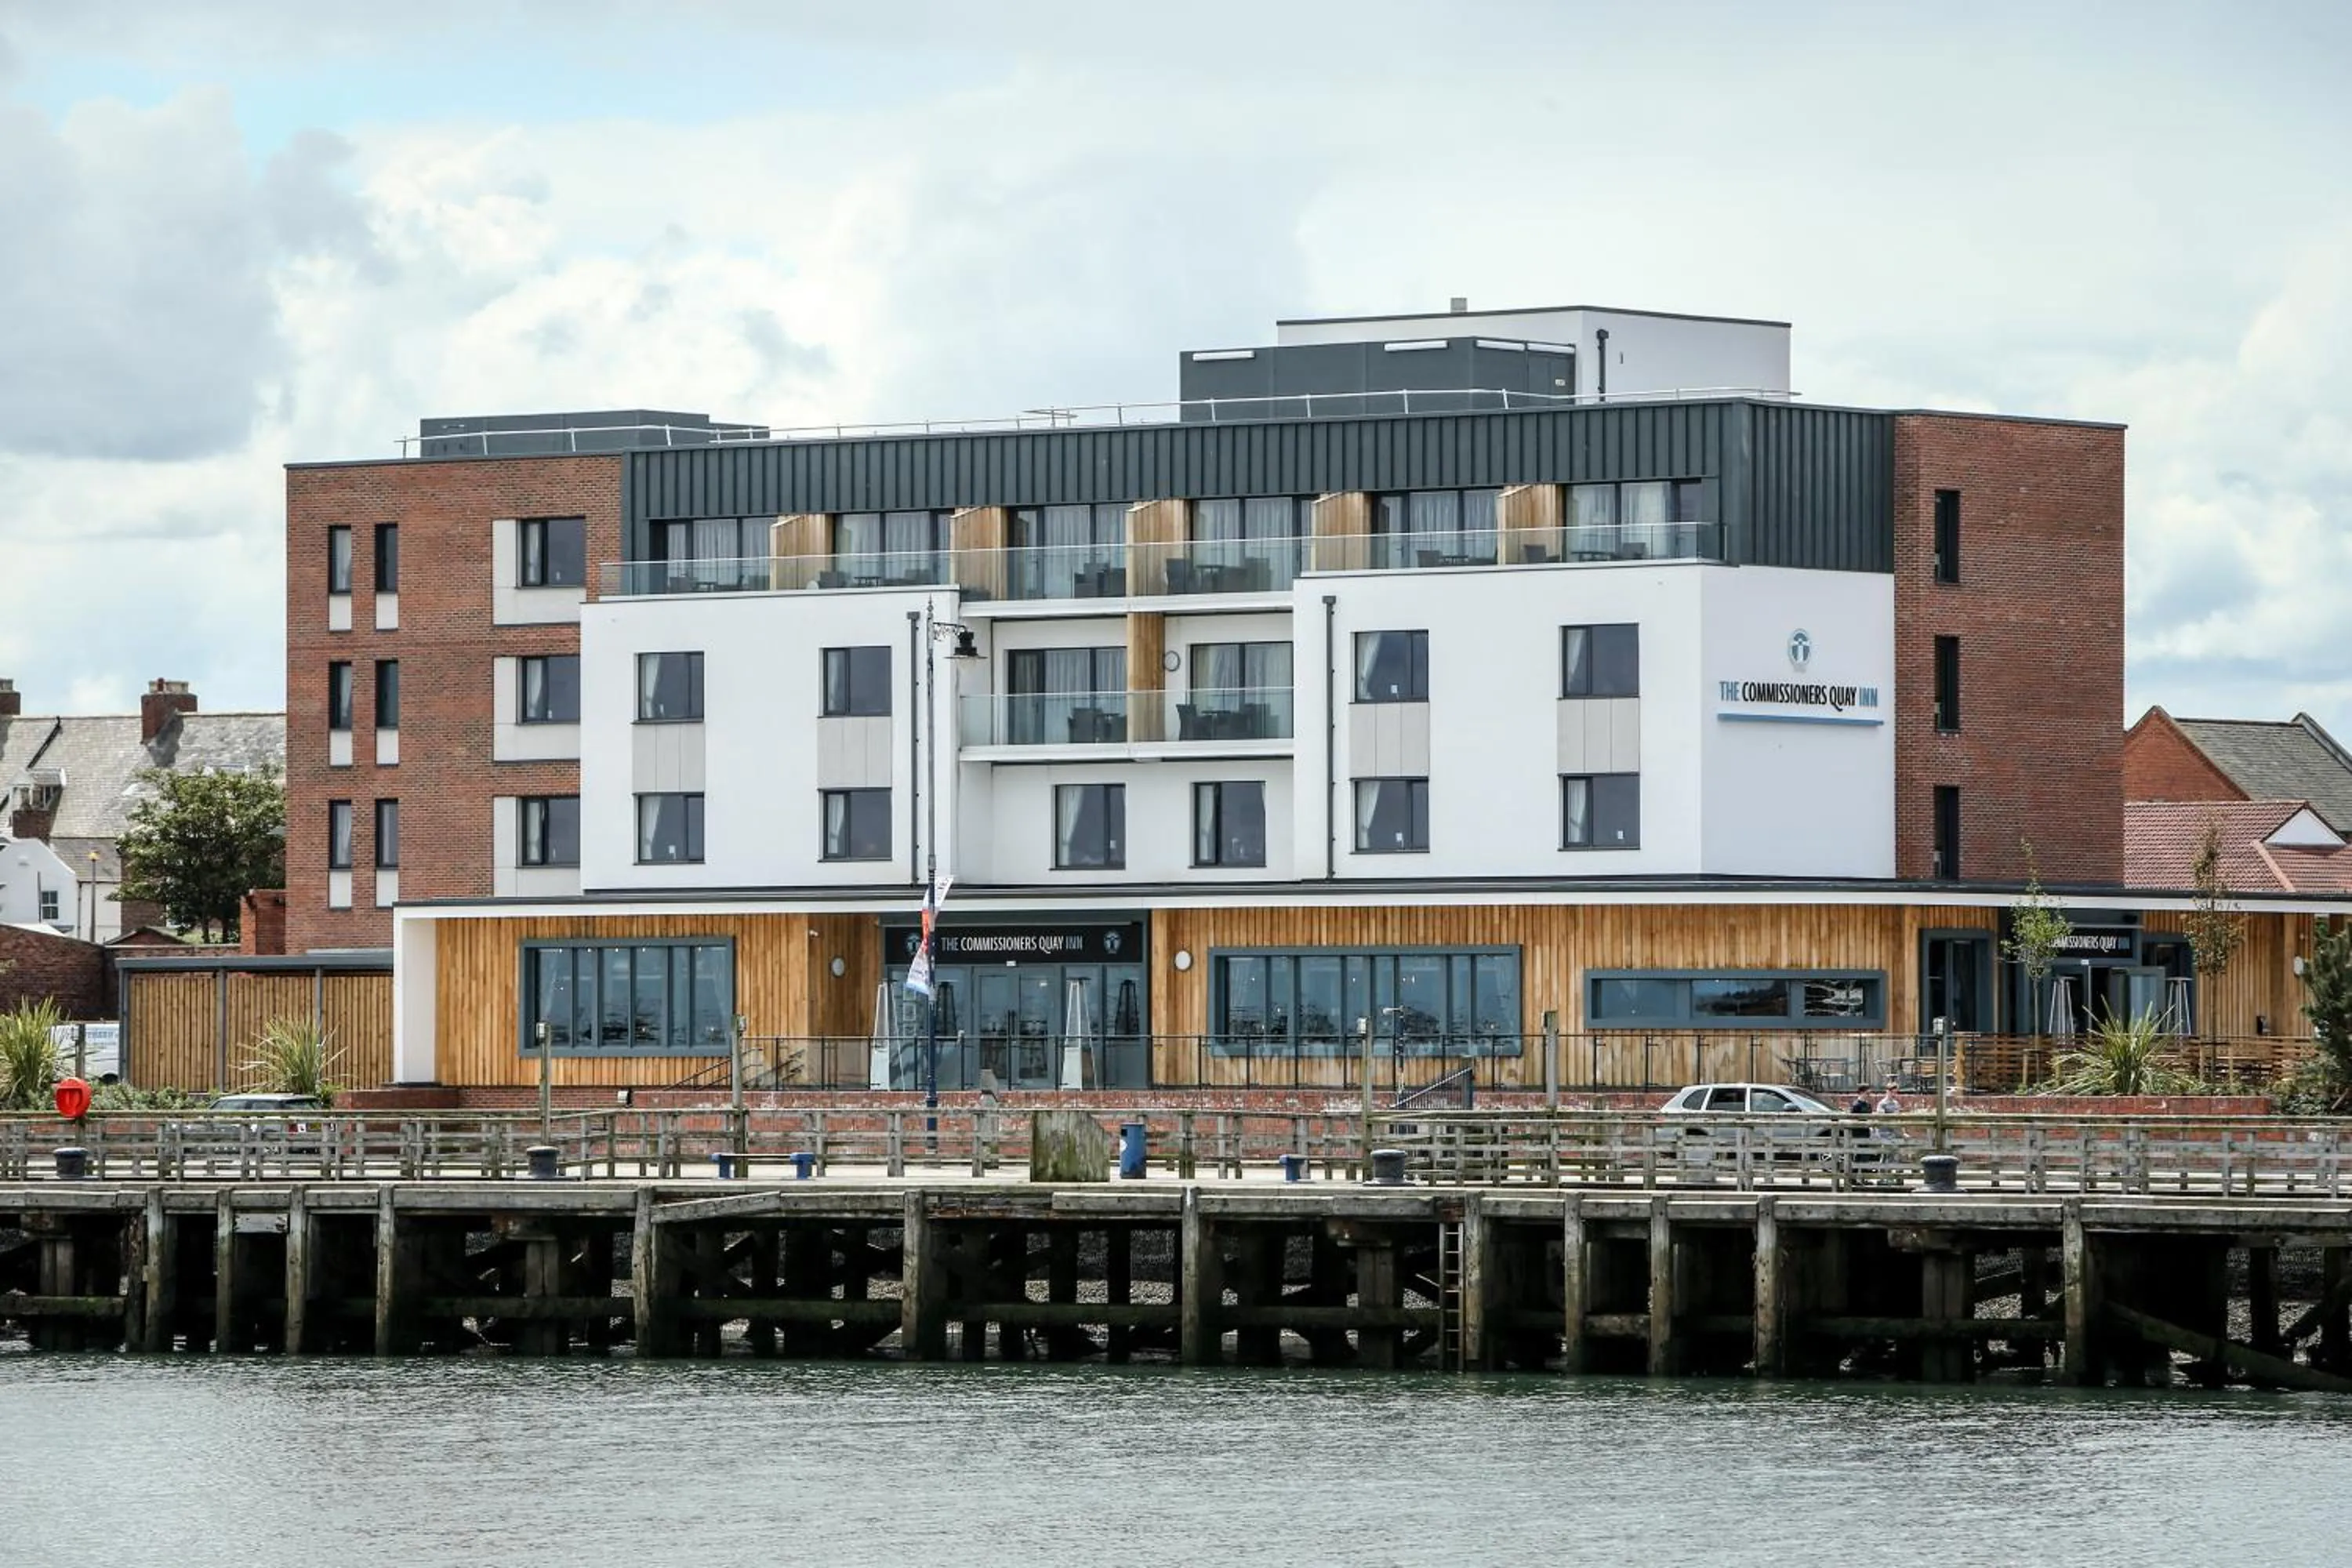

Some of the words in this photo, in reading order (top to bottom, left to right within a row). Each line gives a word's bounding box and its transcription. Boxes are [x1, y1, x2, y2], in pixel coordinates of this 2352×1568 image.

[1719, 681, 1740, 702] THE
[1741, 681, 1828, 705] COMMISSIONERS
[1829, 685, 1857, 712] QUAY
[1858, 687, 1878, 708] INN
[941, 937, 959, 951] THE
[960, 937, 1037, 951] COMMISSIONERS
[1039, 935, 1064, 954] QUAY
[1065, 935, 1083, 950] INN
[2099, 935, 2117, 953] QUAY
